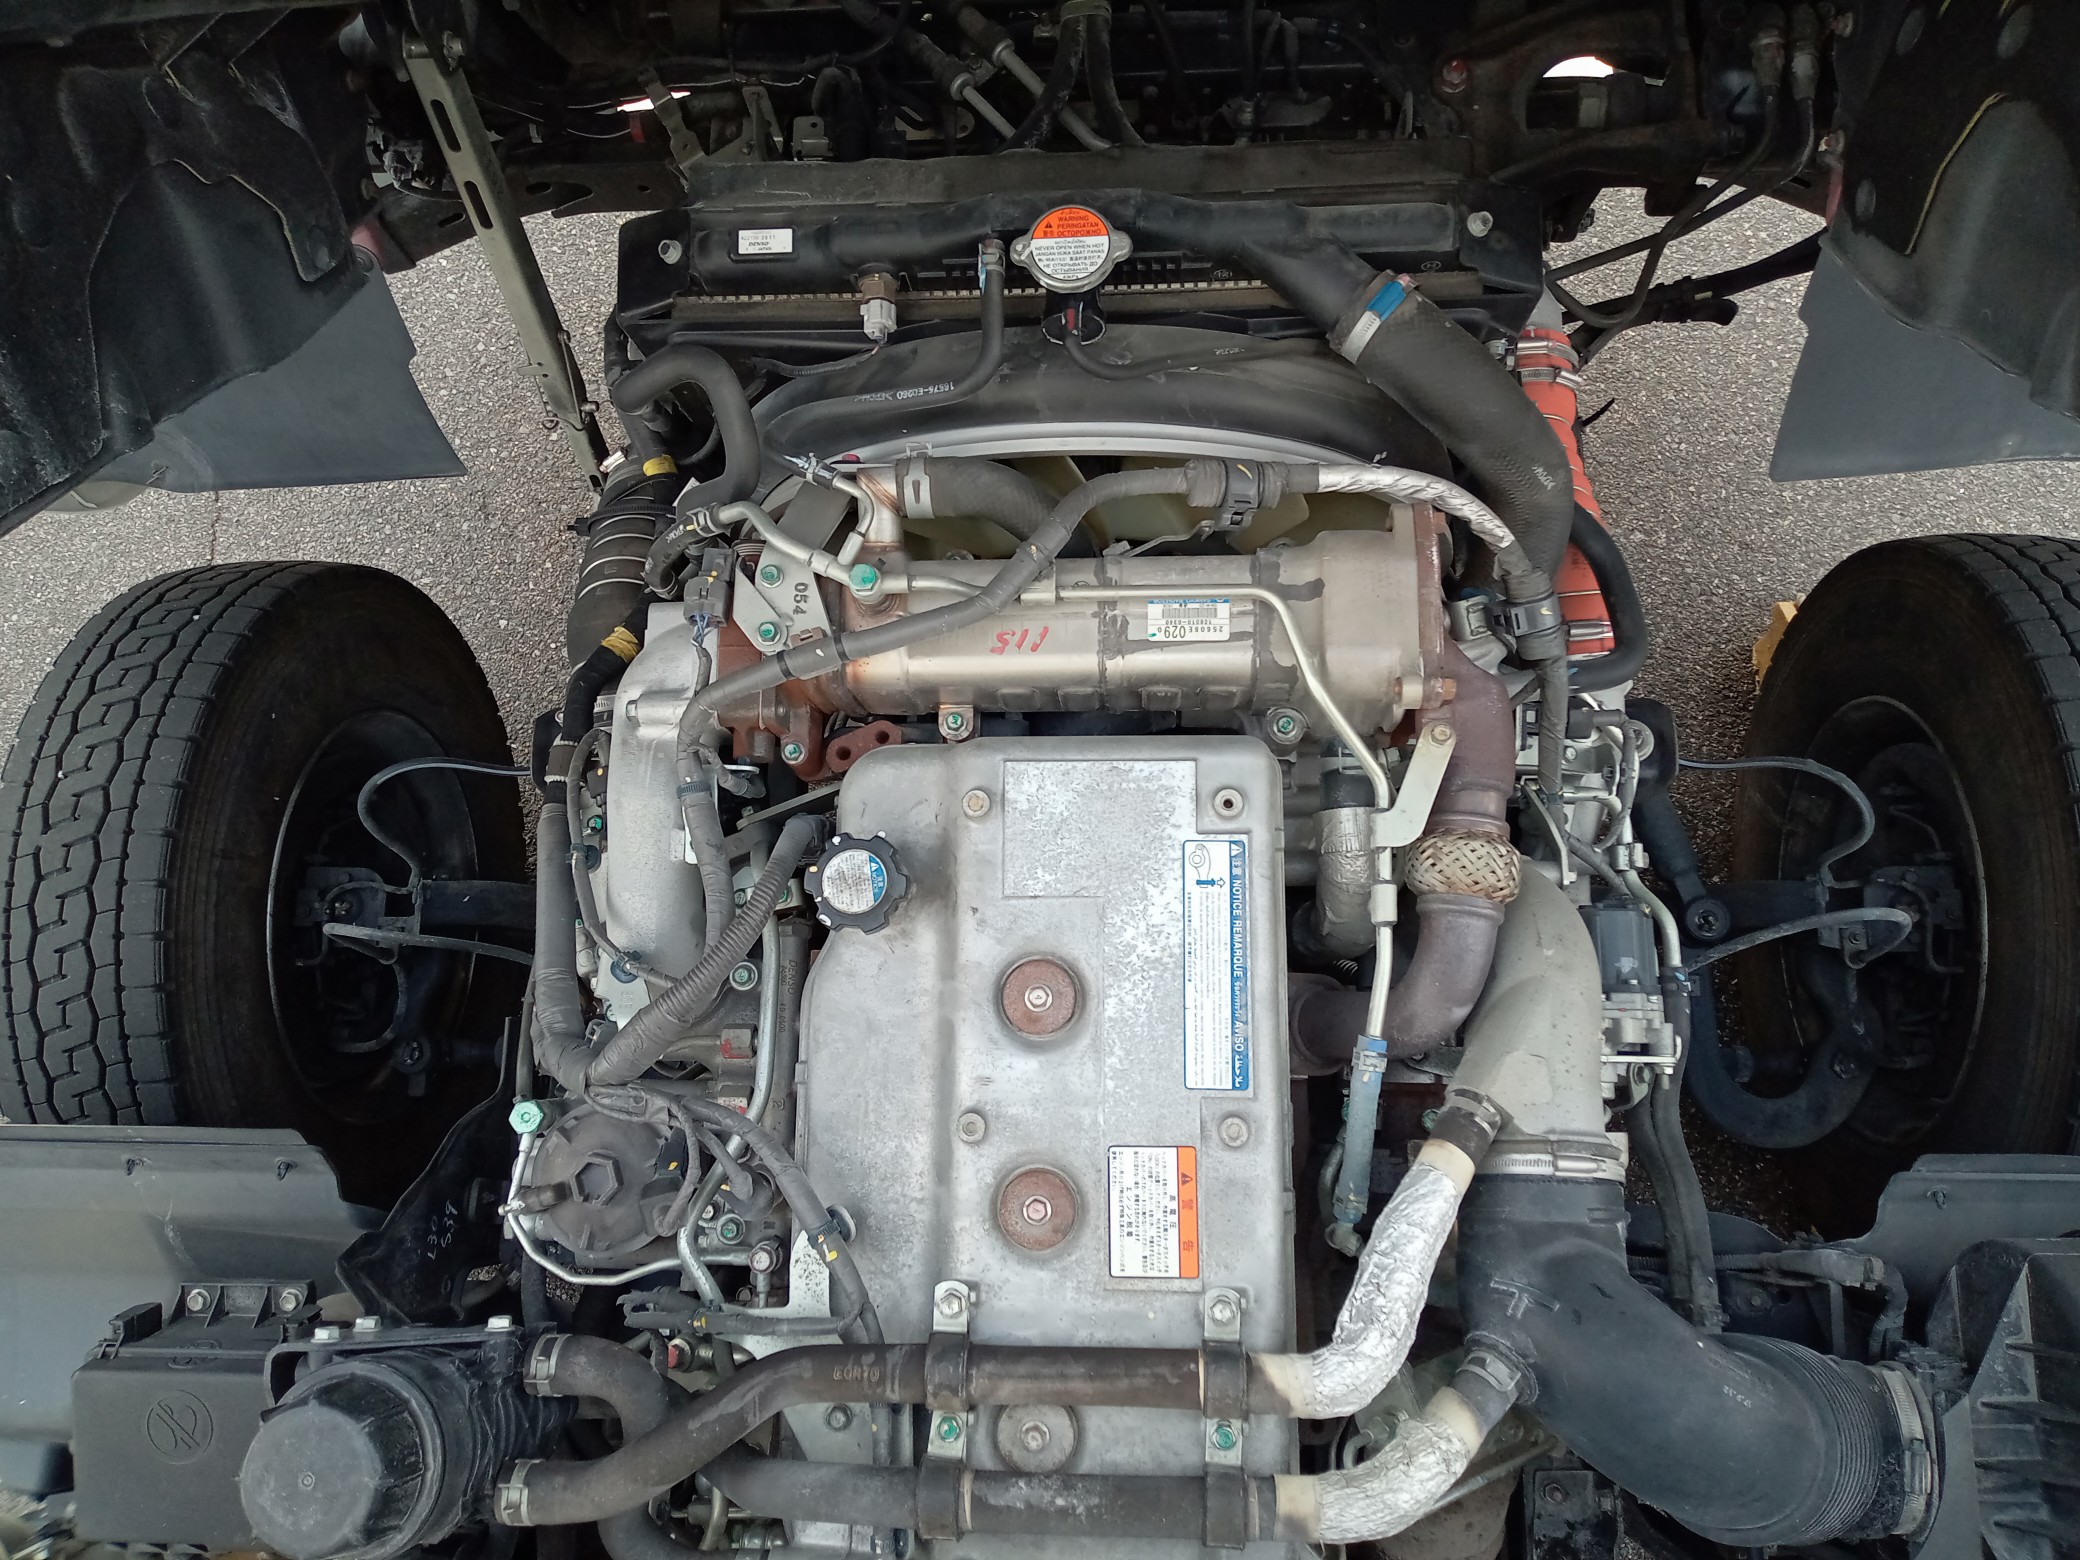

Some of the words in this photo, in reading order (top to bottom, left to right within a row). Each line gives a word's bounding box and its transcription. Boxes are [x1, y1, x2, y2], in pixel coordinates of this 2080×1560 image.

[792, 582, 809, 616] 054
[1232, 880, 1243, 916] NOTICE
[1233, 920, 1243, 977] REMARQUE
[788, 960, 797, 994] DENSO
